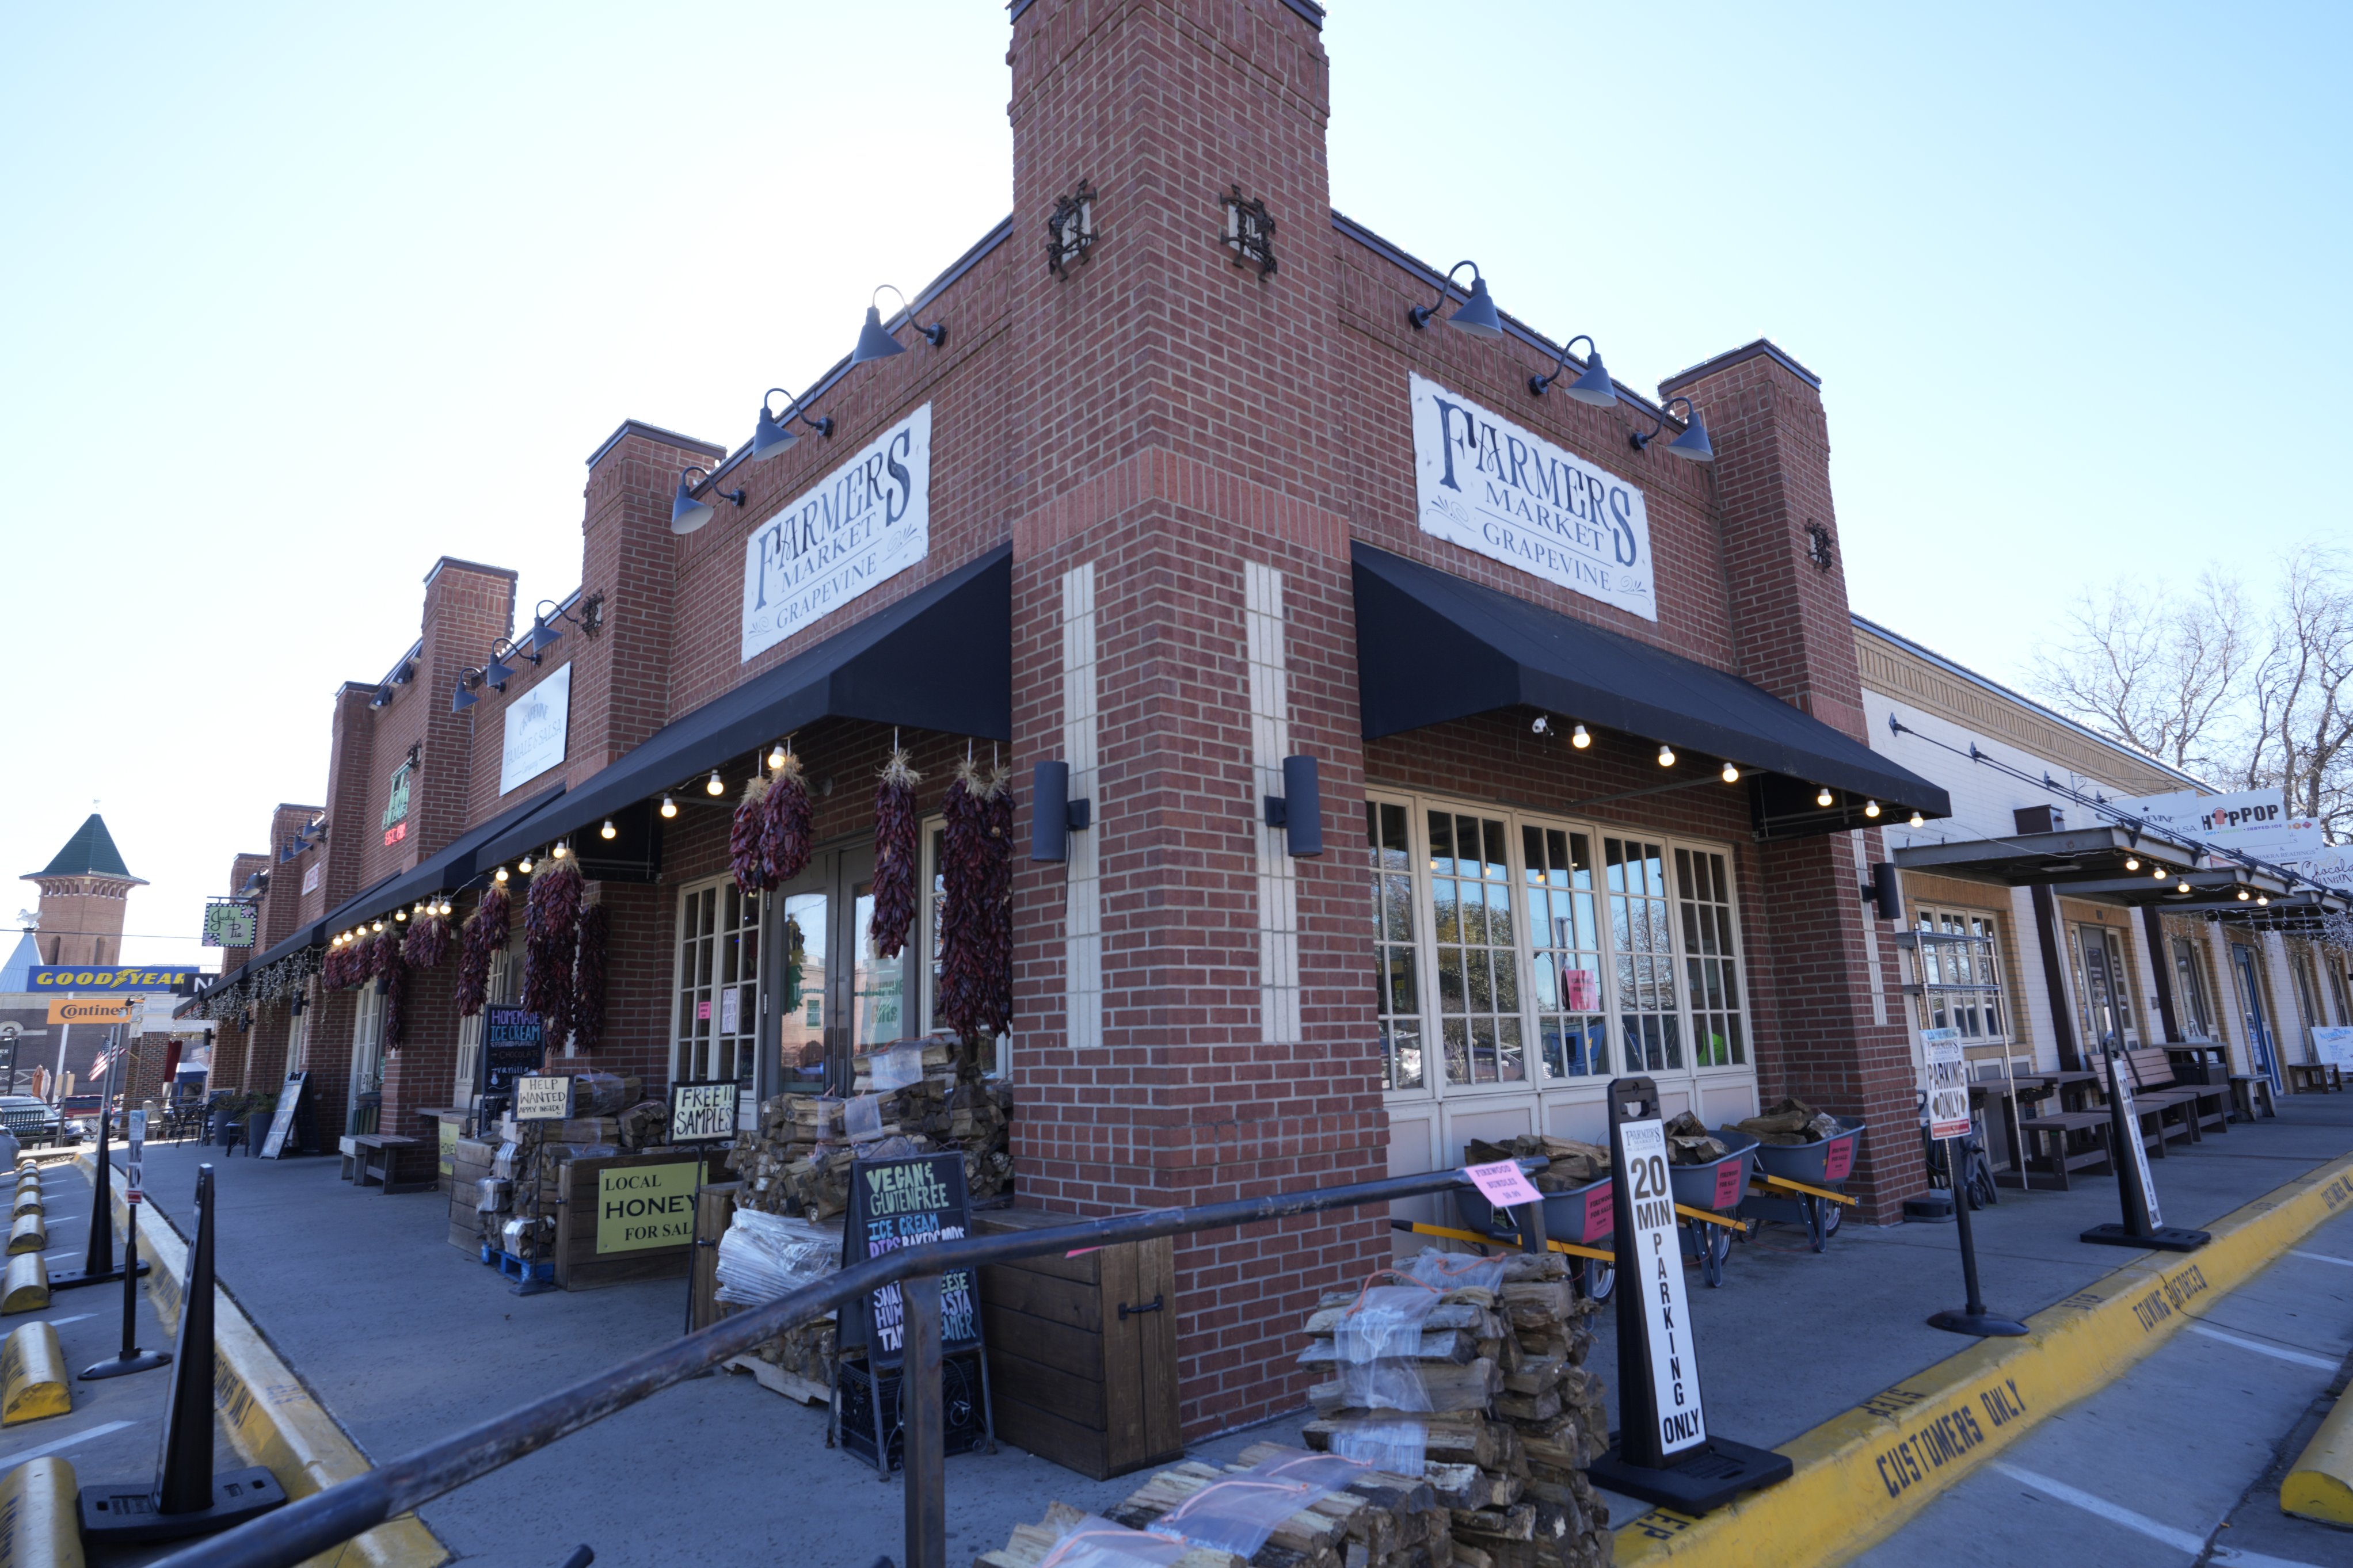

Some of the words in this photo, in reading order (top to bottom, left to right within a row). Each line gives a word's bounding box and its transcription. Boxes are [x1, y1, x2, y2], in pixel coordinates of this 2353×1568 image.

[1433, 395, 1636, 567] FARMERS
[754, 427, 911, 613] FARMERS
[1484, 480, 1604, 552] MARKET
[781, 512, 876, 593] MARKET
[1483, 522, 1611, 592] GRAPEVINE
[777, 552, 876, 629] GRAPEVINE
[506, 737, 532, 766] TAMALE
[539, 719, 562, 743] SALSA
[2141, 815, 2175, 823] PEVINE
[211, 907, 235, 931] Judy
[227, 923, 243, 938] Pie
[60, 1005, 130, 1019] Contine
[492, 1010, 540, 1024] HOMEMADE
[490, 1026, 507, 1041] ICE
[509, 1025, 540, 1041] CREAM
[499, 1050, 539, 1059] CHOCOLATE
[530, 1079, 558, 1090] HELP
[1927, 1060, 1964, 1090] PARKING
[520, 1092, 565, 1104] WANTED
[682, 1086, 732, 1107] FREE!!
[2119, 1079, 2130, 1101] 20
[1939, 1091, 1960, 1120] ONLY
[676, 1107, 732, 1135] SAMPLES
[1626, 1127, 1661, 1146] FARMERS
[604, 1174, 661, 1191] LOCAL
[866, 1163, 924, 1193] VEGAN
[1475, 1165, 1511, 1177] FIREWOOD
[1486, 1178, 1518, 1189] BUNDLES
[1631, 1155, 1666, 1199] 20
[606, 1194, 695, 1219] HONEY
[1590, 1209, 1600, 1219] FOR
[1636, 1200, 1671, 1230] MIN
[625, 1225, 658, 1241] FOR
[663, 1222, 692, 1237] SAL
[868, 1220, 893, 1241] ICE
[899, 1212, 939, 1235] CREAM
[941, 1289, 973, 1316] ASTA
[2133, 1290, 2171, 1332] TOWING
[2163, 1264, 2208, 1310] ENFORCED
[1653, 1233, 1684, 1406] PARKING
[1663, 1408, 1699, 1444] ONLY
[1876, 1405, 1983, 1498] CUSTOMERS
[1980, 1379, 2025, 1426] ONLY
